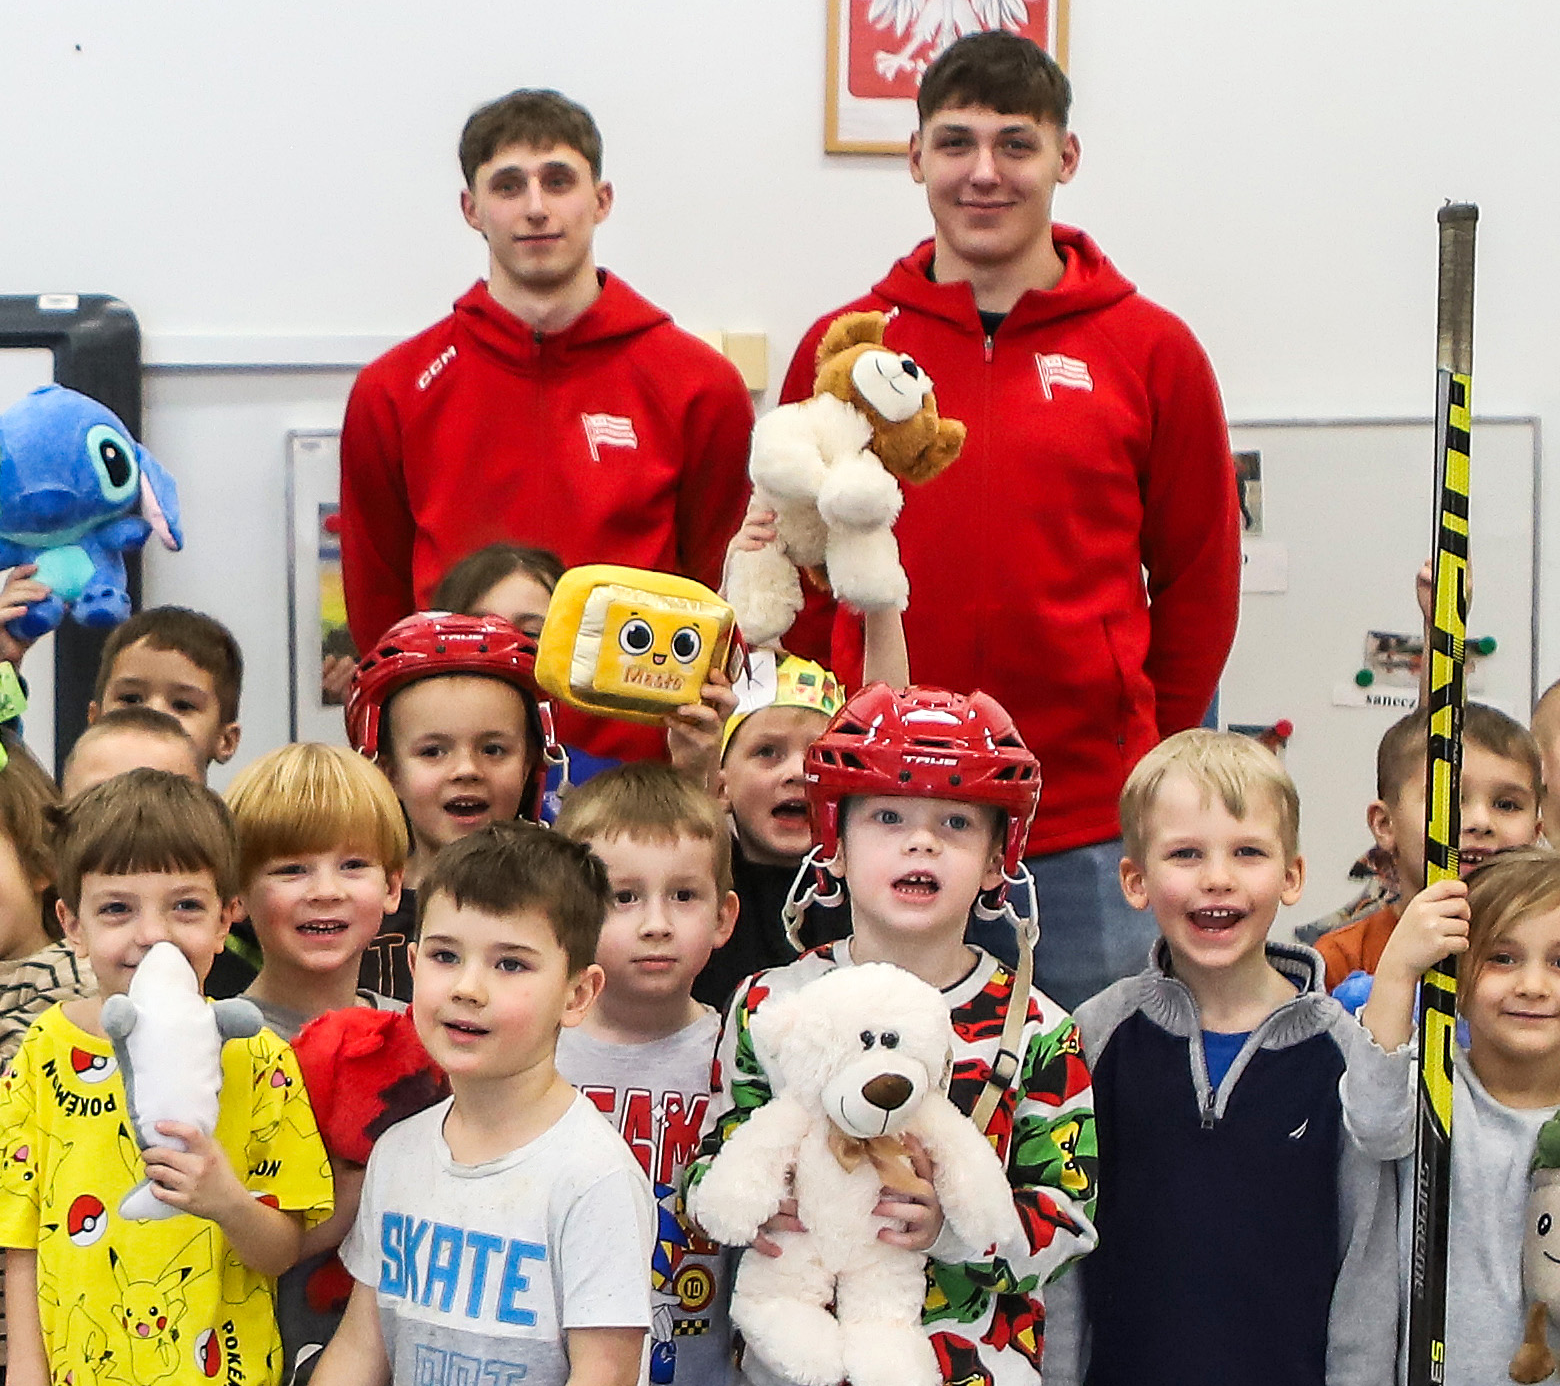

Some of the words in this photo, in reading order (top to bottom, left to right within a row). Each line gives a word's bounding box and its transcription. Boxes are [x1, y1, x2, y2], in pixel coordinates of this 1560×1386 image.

[902, 755, 958, 766] TRUE
[41, 1059, 117, 1117] POKÉMON
[571, 1085, 711, 1184] AM
[378, 1211, 548, 1327] SKATE
